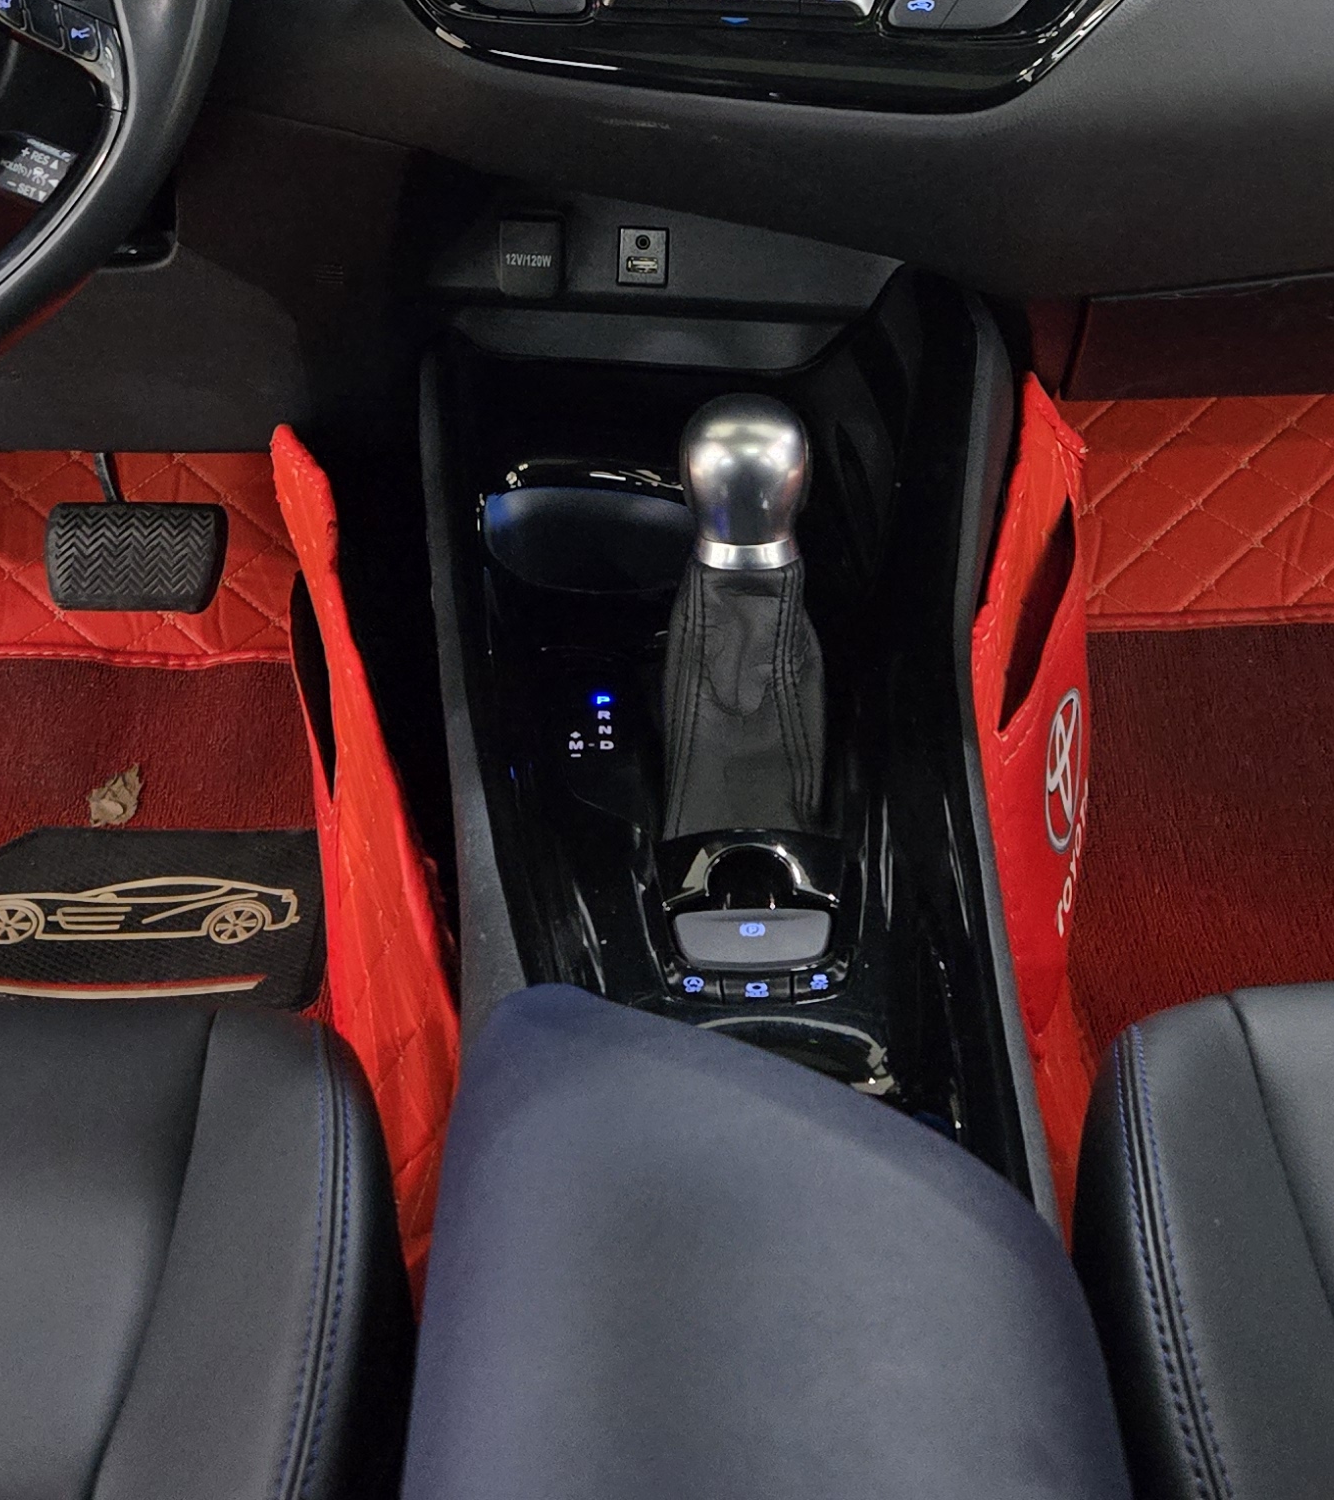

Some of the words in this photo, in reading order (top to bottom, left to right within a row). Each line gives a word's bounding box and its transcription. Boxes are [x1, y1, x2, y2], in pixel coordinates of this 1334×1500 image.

[17, 182, 37, 198] SET
[505, 253, 552, 268] 12V/120W
[596, 695, 610, 705] P
[597, 710, 611, 720] R
[598, 725, 612, 735] N
[568, 740, 584, 750] M
[600, 740, 614, 750] D
